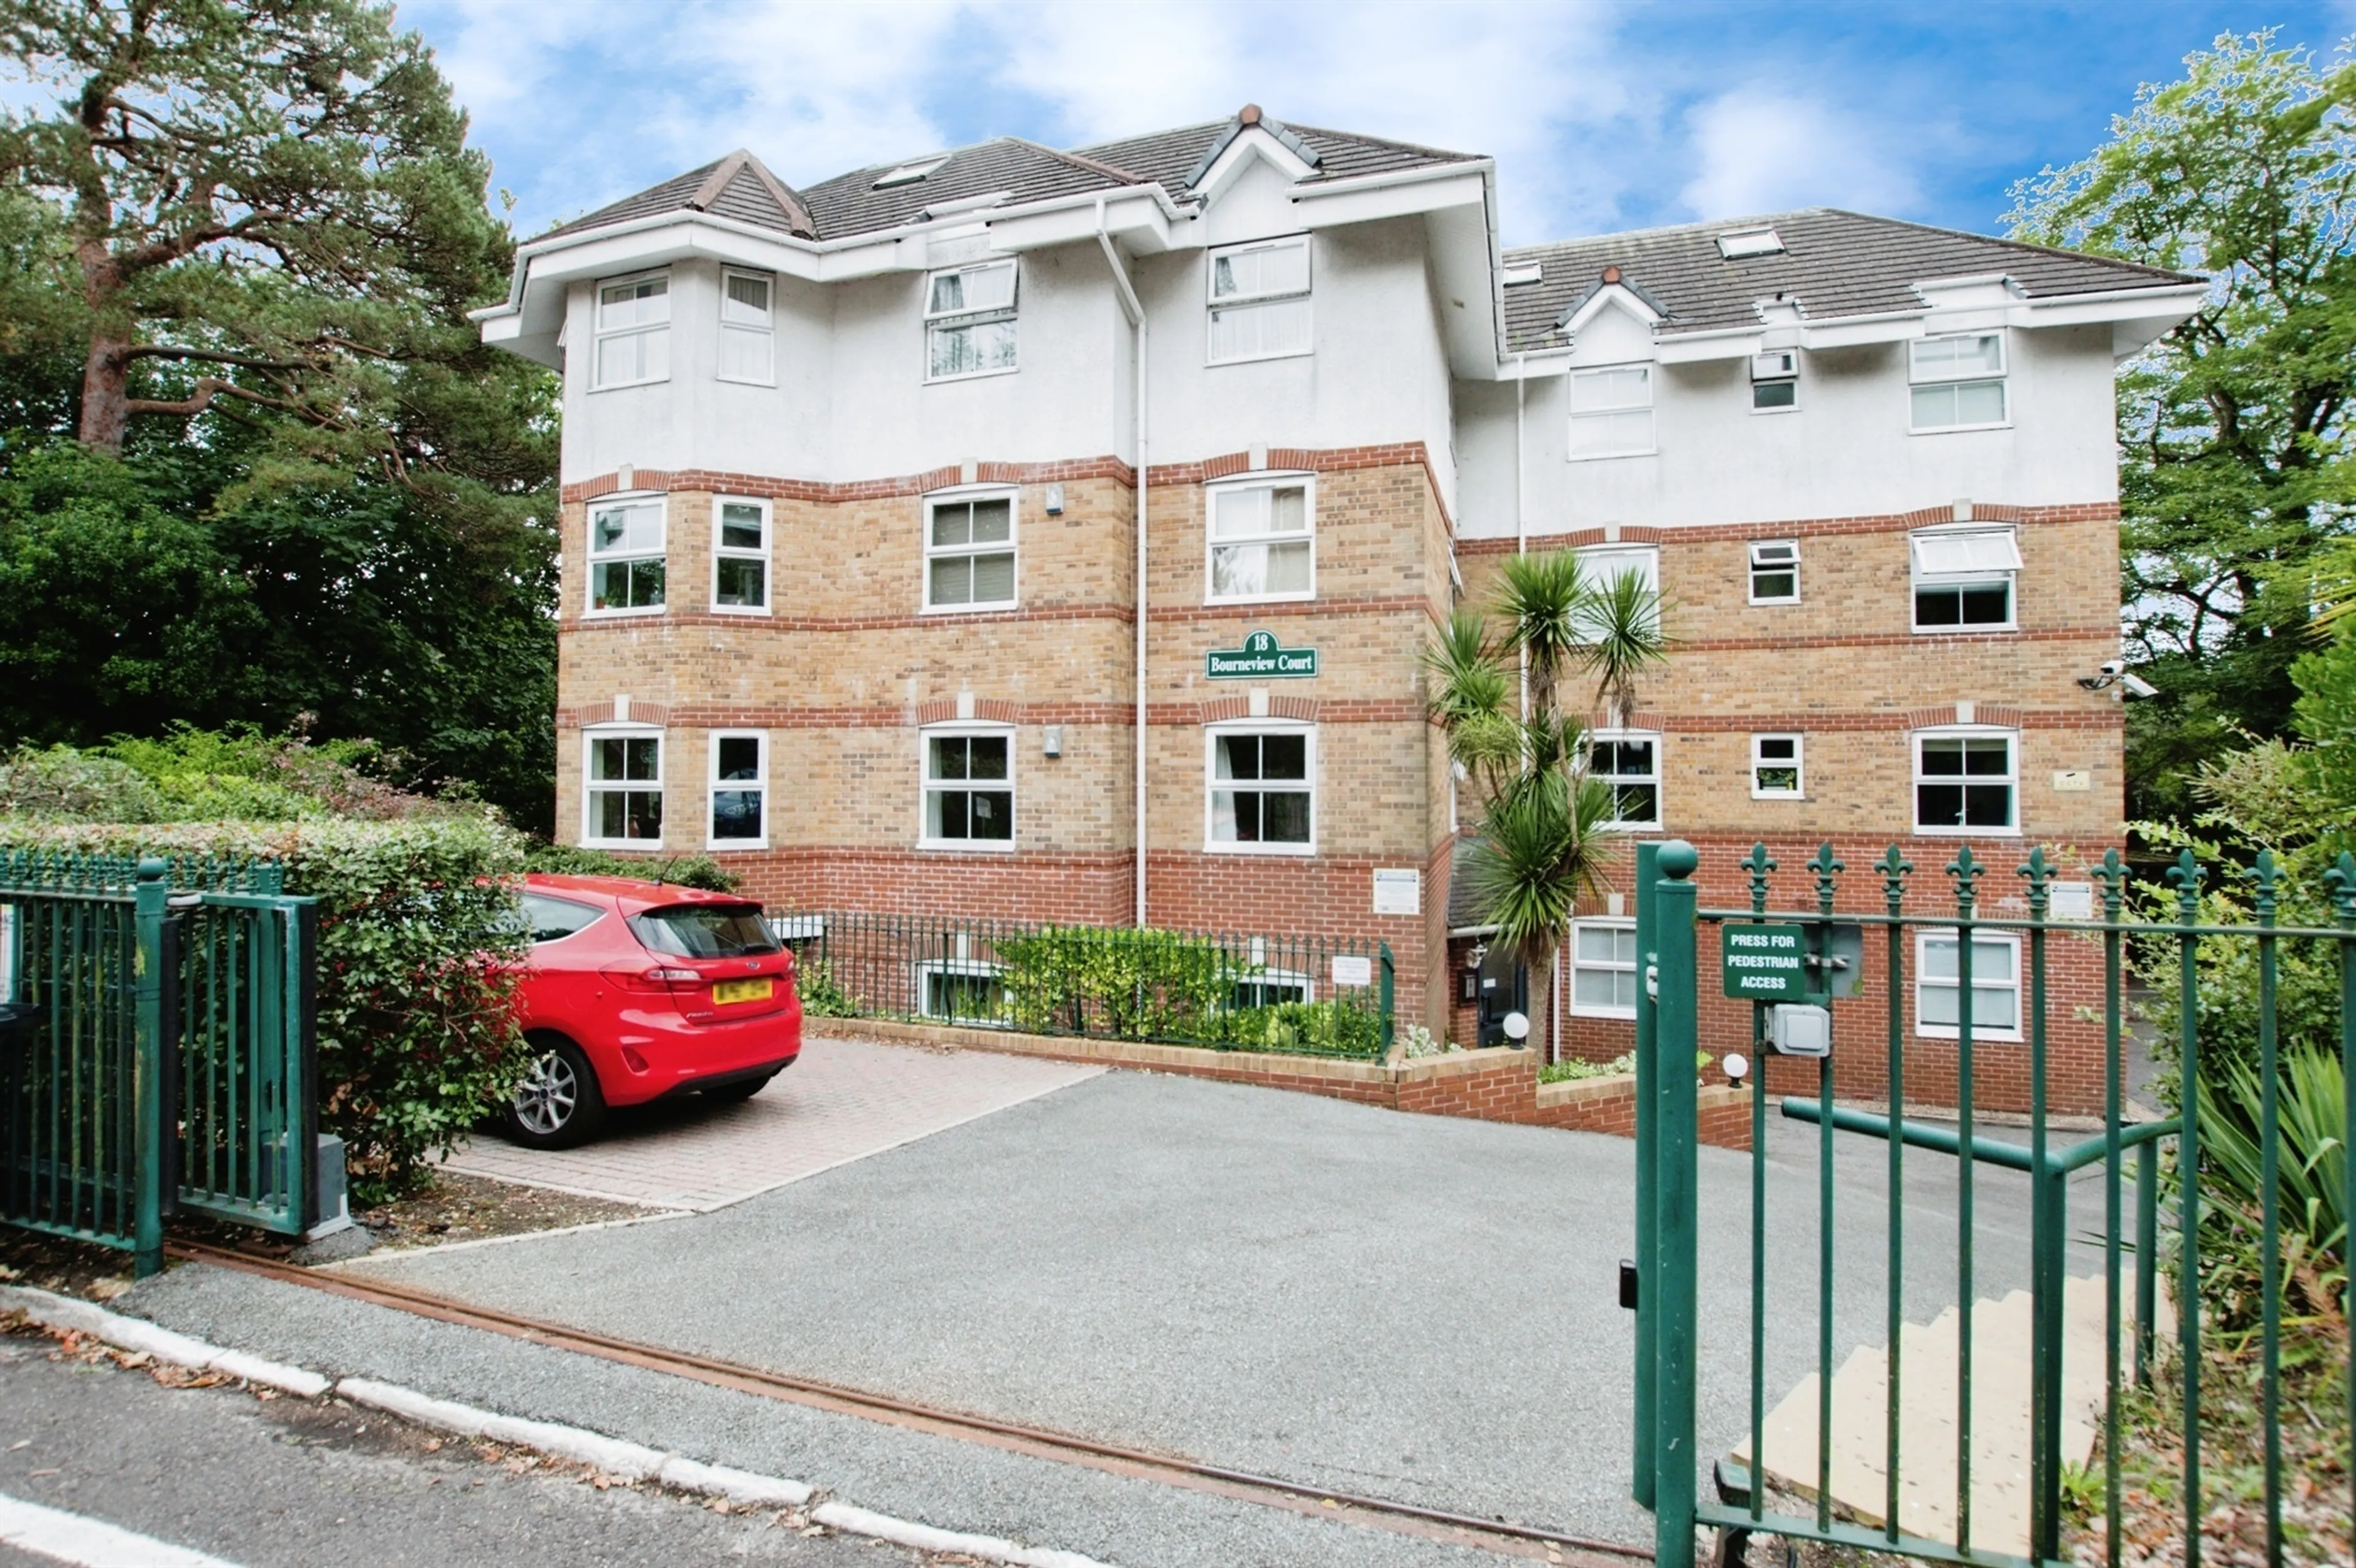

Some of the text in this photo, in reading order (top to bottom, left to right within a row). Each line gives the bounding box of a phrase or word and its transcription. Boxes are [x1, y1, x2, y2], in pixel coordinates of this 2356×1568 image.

[1254, 634, 1268, 651] 18
[1211, 655, 1312, 672] Bourneview Court
[1731, 934, 1795, 948] PRESS FOR
[1728, 955, 1799, 969] PEDESTRIAN
[1741, 976, 1786, 989] ACCESS
